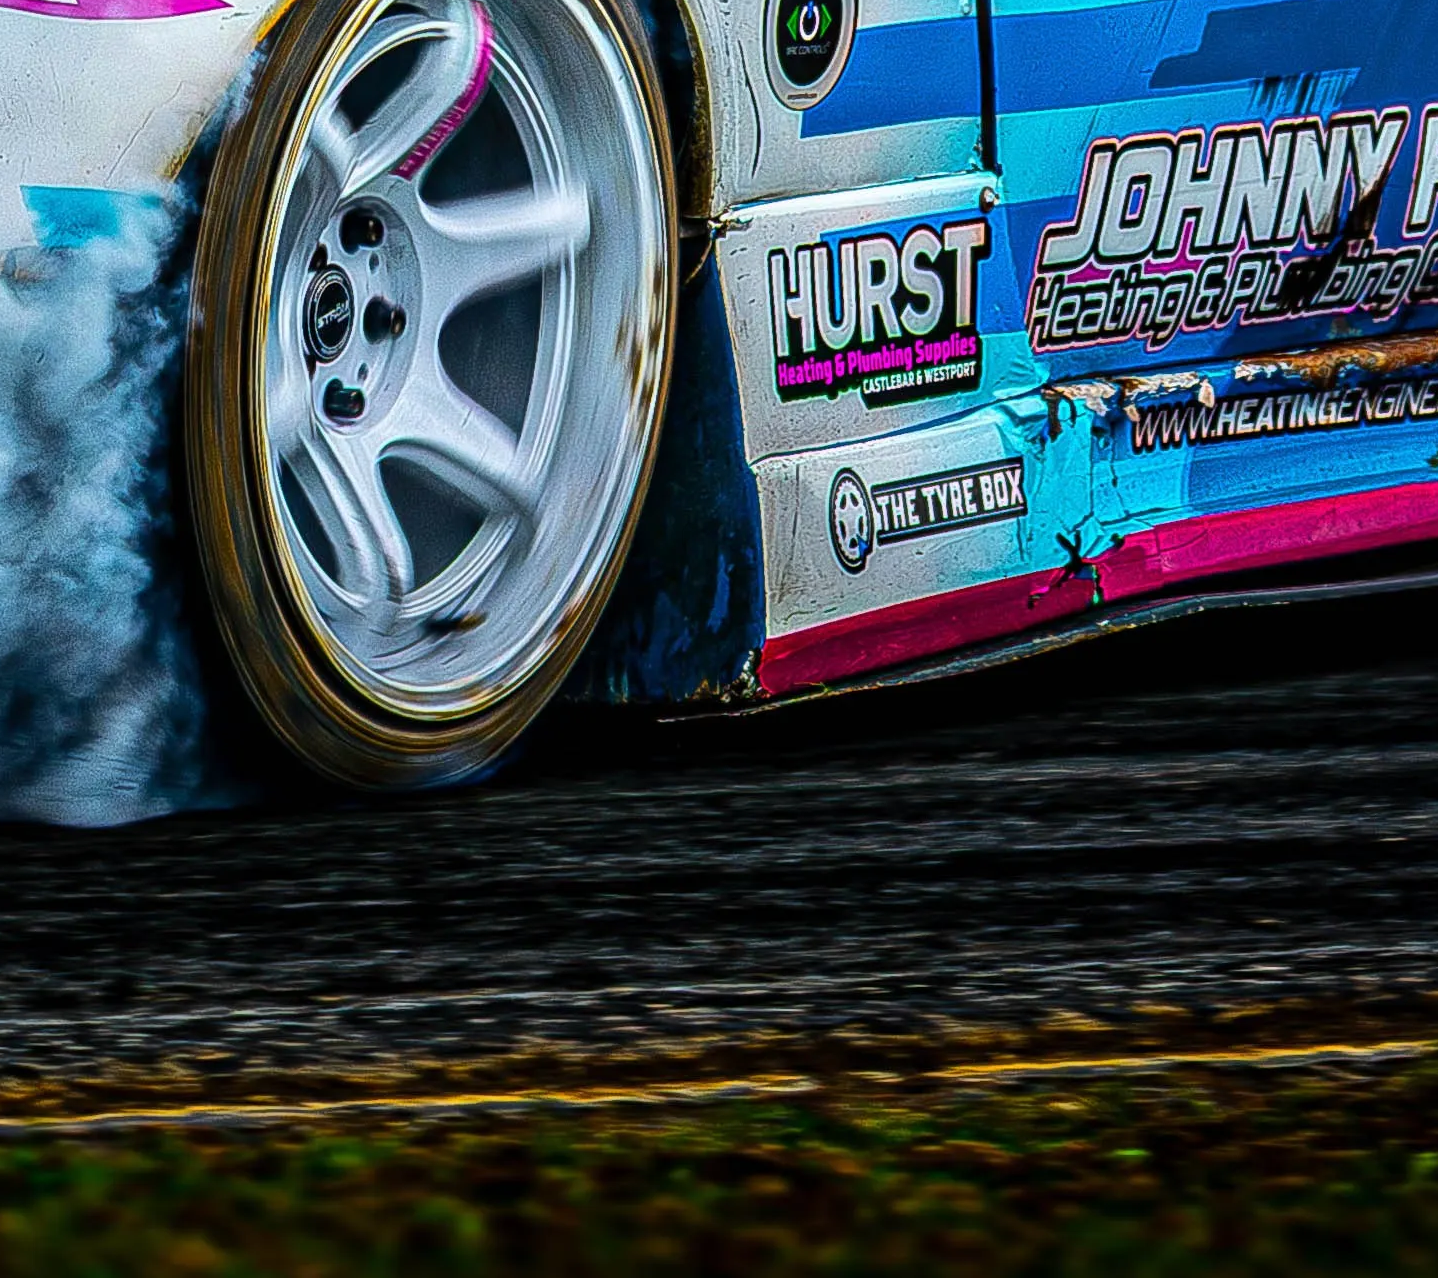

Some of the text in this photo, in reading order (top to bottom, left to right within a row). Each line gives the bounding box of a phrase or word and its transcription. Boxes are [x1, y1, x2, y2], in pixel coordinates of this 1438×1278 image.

[1040, 117, 1404, 267] JOHNNY
[770, 221, 986, 357] HURST
[1029, 267, 1188, 347] Heating
[1191, 255, 1228, 325] &
[778, 331, 977, 387] Heating & Plumbing Supplies
[862, 360, 977, 394] CASTLEBAR & WESTPORT
[875, 468, 1024, 532] THE TYRE BOX
